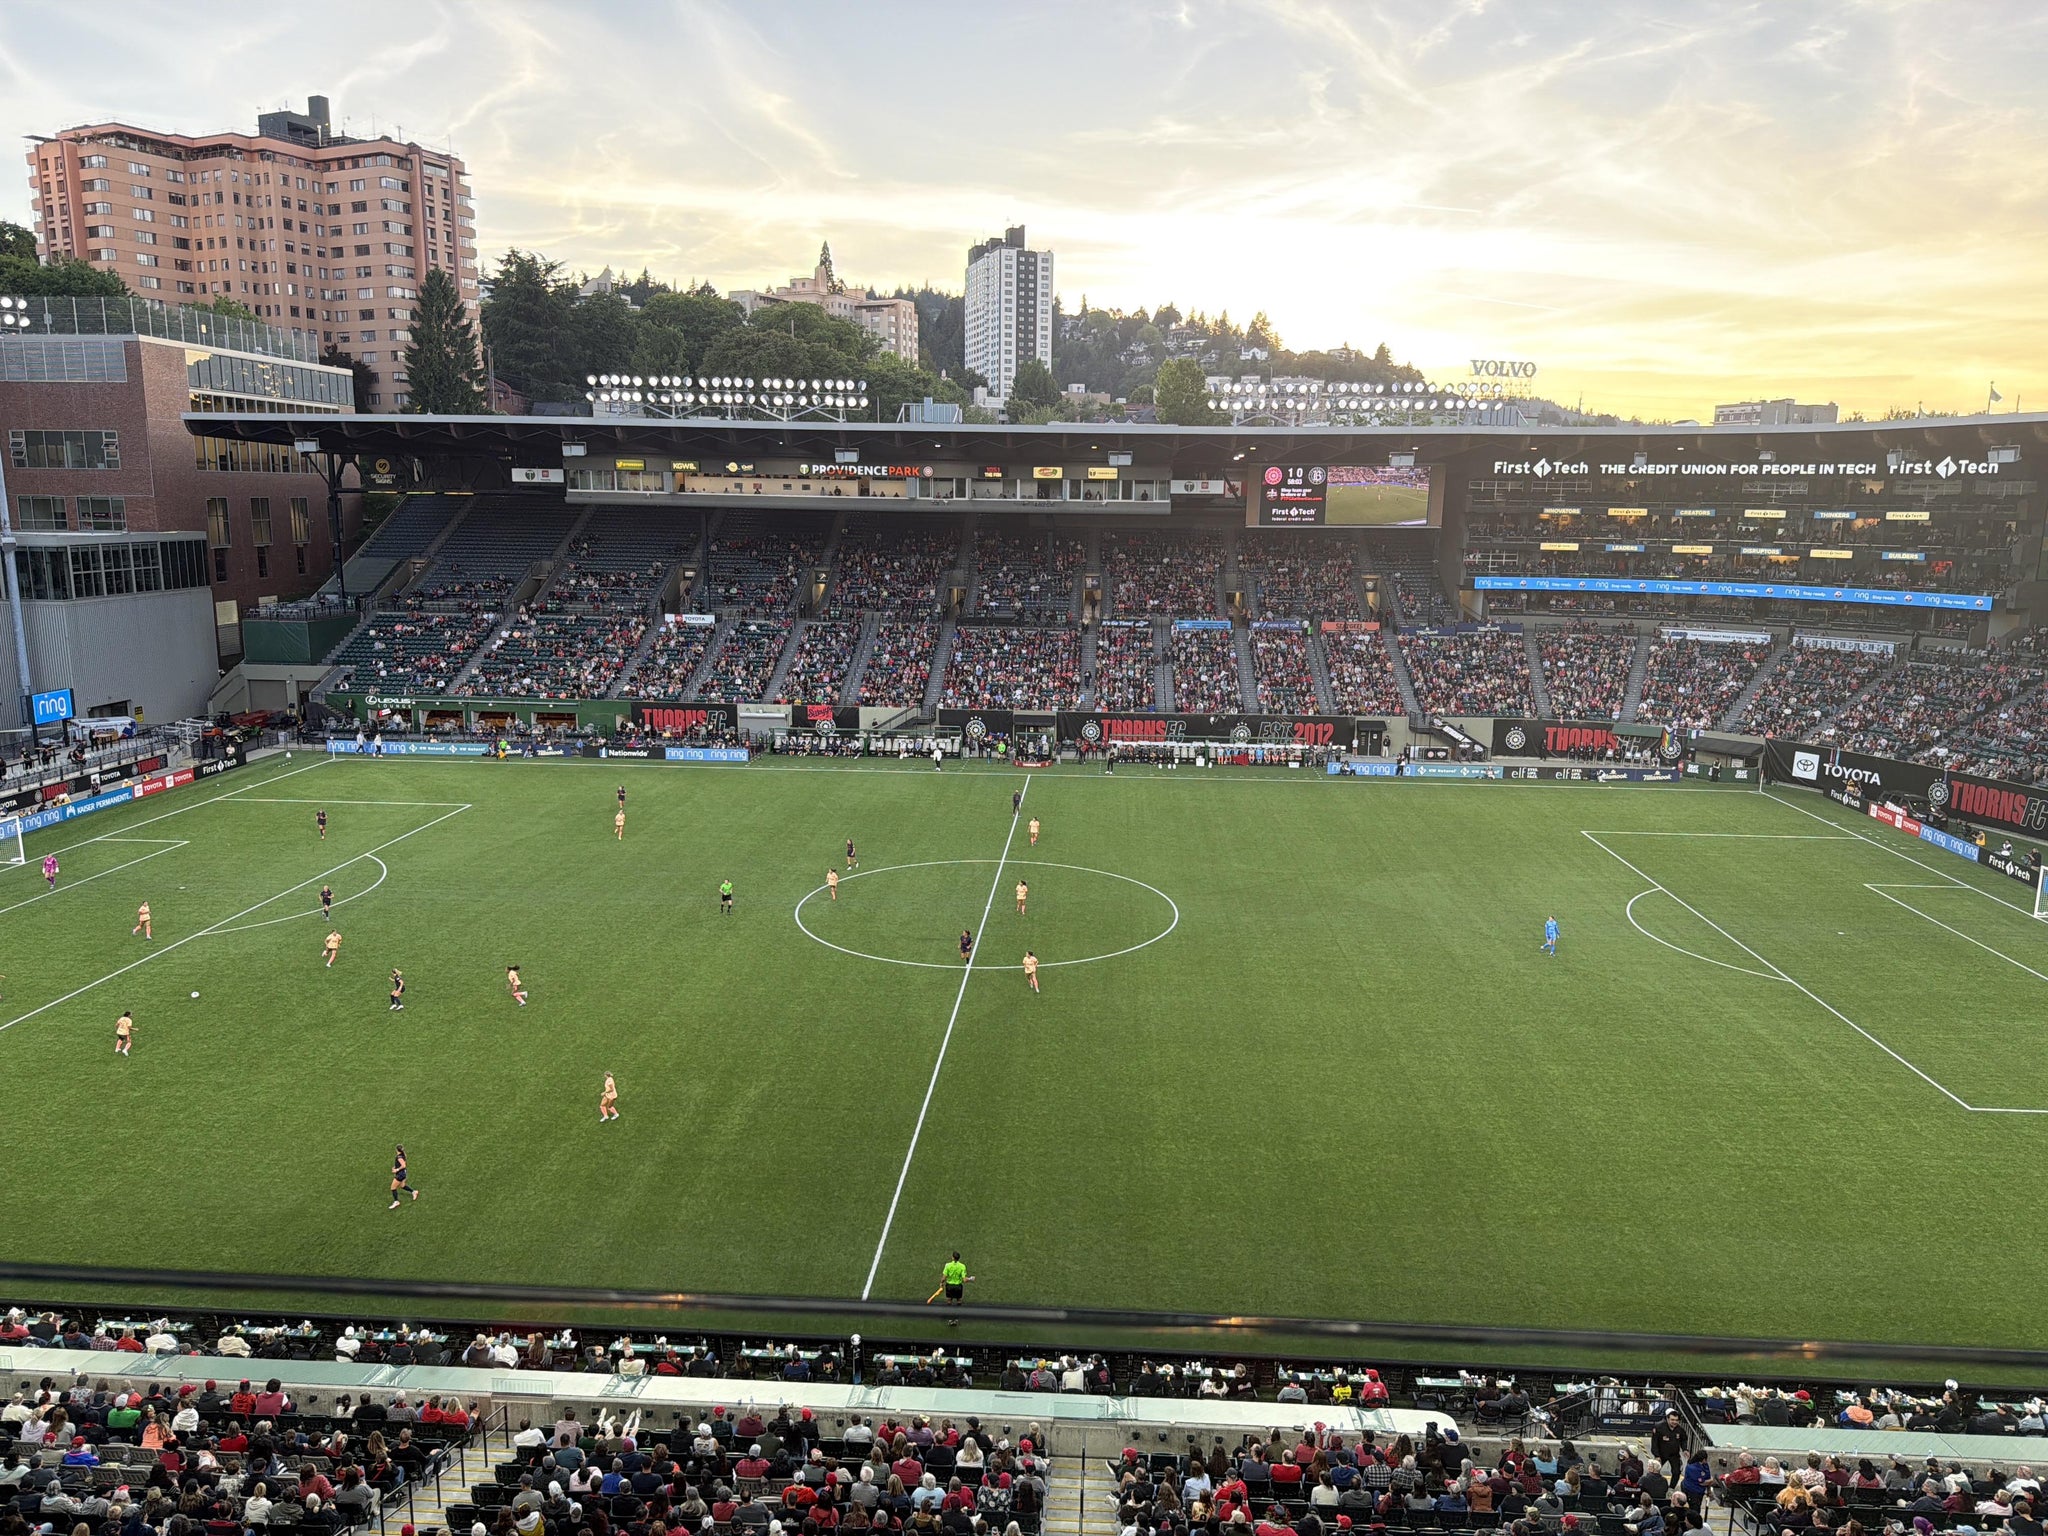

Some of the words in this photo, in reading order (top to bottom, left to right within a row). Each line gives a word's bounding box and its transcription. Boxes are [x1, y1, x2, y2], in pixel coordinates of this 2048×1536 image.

[1470, 360, 1537, 378] VOLVO
[1494, 461, 1530, 474] First
[1552, 461, 1589, 474] Tech
[1600, 464, 1626, 474] THE
[1628, 464, 1679, 474] CREDIT
[1681, 464, 1728, 475] UNION
[1730, 464, 1758, 475] FOR
[1762, 464, 1815, 475] PEOPLE
[1818, 464, 1834, 475] IN
[1837, 464, 1876, 475] TECH
[1479, 579, 1492, 588] ring
[1536, 580, 1549, 589] ring
[1596, 582, 1609, 590] ring
[1656, 583, 1670, 591] ring
[1718, 585, 1732, 594] ring
[1785, 588, 1800, 597] ring
[1854, 592, 1869, 600] ring
[1925, 596, 1940, 605] ring
[39, 694, 67, 717] ring
[641, 708, 707, 736] THORNS
[706, 709, 727, 733] FC
[1101, 719, 1166, 742] THORNS
[1165, 720, 1187, 744] FC
[1293, 723, 1334, 745] 2012
[1545, 727, 1618, 752] THORNS
[390, 743, 406, 753] ring
[609, 749, 649, 757] Nationwide
[666, 749, 684, 760] ring
[687, 749, 704, 760] ring
[711, 749, 728, 760] ring
[730, 750, 747, 761] ring
[203, 765, 217, 775] First
[223, 758, 237, 768] Tech
[1352, 763, 1370, 774] ring
[1373, 763, 1391, 775] ring
[101, 771, 121, 781] TOYOTA
[174, 773, 193, 783] TOYOTA
[1511, 767, 1526, 779] elf
[1555, 768, 1570, 780] elf
[1823, 763, 1881, 785] TOYOTA
[143, 781, 162, 791] TOYOTA
[1830, 789, 1843, 801] First
[1848, 796, 1860, 808] Tech
[77, 803, 95, 814] KAISER
[1951, 780, 2026, 825] THORNS
[2020, 796, 2048, 830] FC
[25, 817, 42, 829] ring
[44, 810, 60, 822] ring
[1877, 810, 1893, 821] TOYOTA
[1902, 820, 1919, 832] TOYOTA
[1921, 827, 1933, 842] ring
[1934, 832, 1947, 847] ring
[1951, 838, 1963, 855] ring
[1966, 845, 1978, 860] ring
[1988, 855, 2005, 870] First
[2014, 866, 2030, 881] Tech
